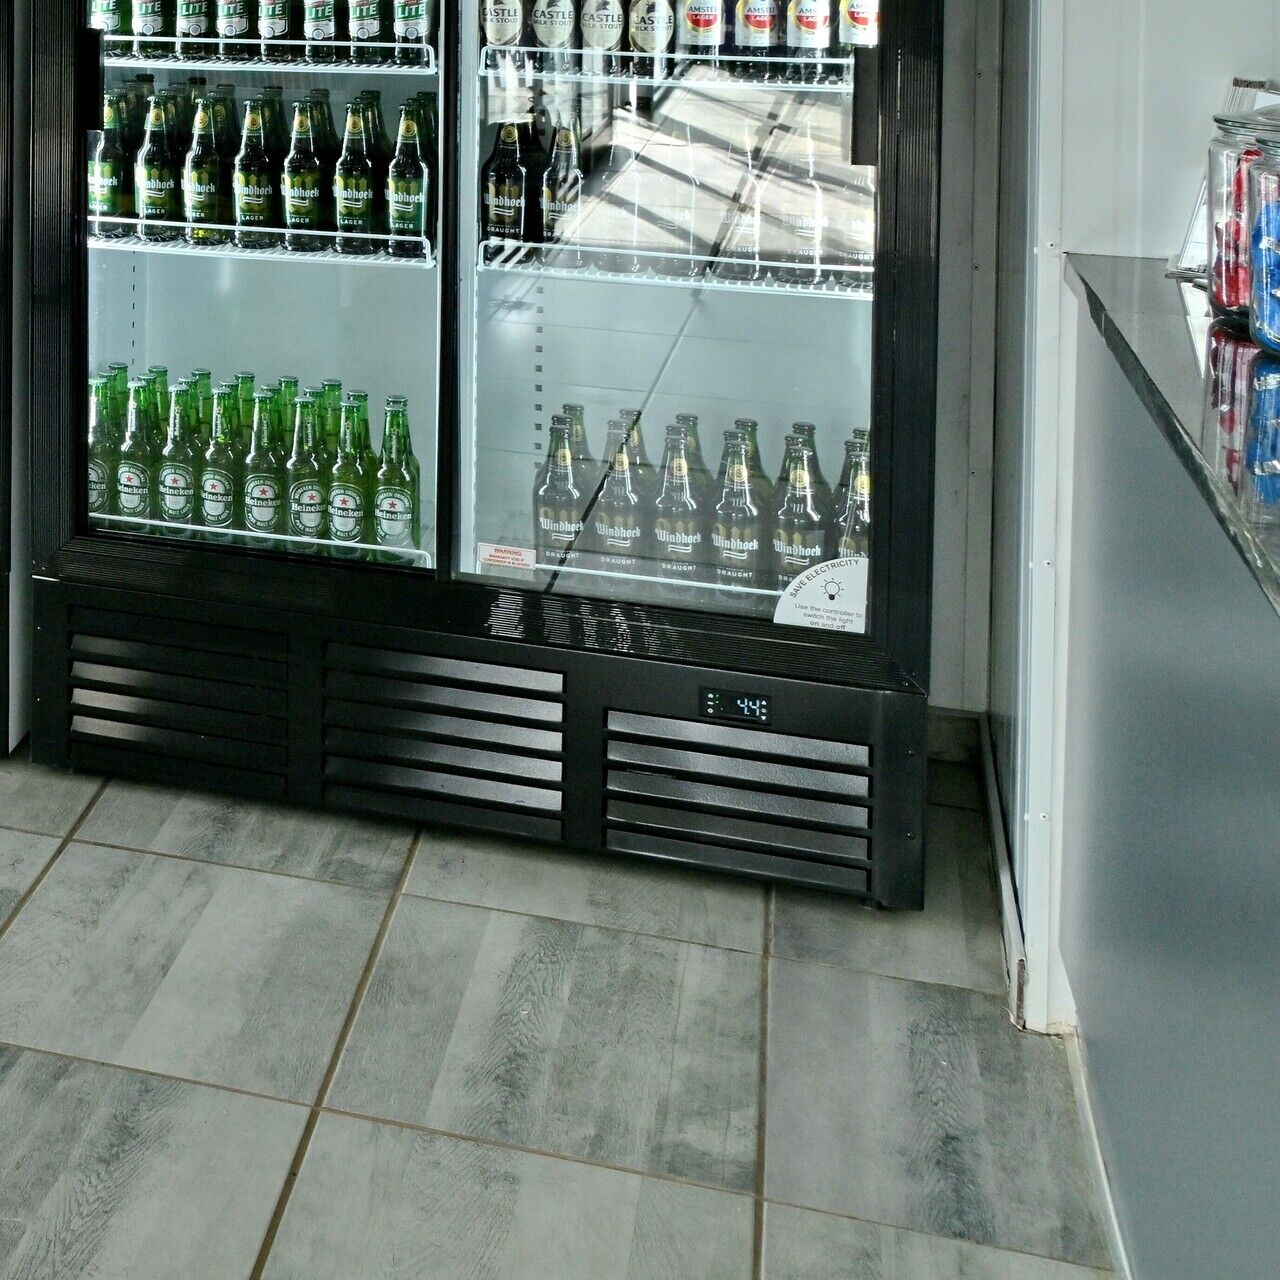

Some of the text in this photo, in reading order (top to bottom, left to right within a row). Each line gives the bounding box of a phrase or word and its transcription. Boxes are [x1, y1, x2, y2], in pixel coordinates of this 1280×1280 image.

[534, 11, 573, 20] CASTLE
[583, 14, 623, 23] CASTLE
[487, 226, 520, 234] DRAUGHT
[291, 503, 326, 513] Heineke
[375, 508, 412, 520] Heineken
[540, 517, 584, 532] Windhoek
[595, 521, 641, 538] Windhoek
[655, 528, 701, 545] Windhoek
[711, 533, 758, 551] Windhoek
[494, 548, 522, 556] WARNING
[773, 539, 820, 557] Windhoek
[545, 551, 579, 559] DRAUGHT
[601, 556, 636, 565] DRAUGHT
[662, 563, 697, 572] DRAUGHT
[717, 568, 752, 578] DRAUGHT
[790, 559, 859, 598] SAVE ELECTRICITY
[803, 612, 824, 620] switch
[823, 608, 854, 617] controller
